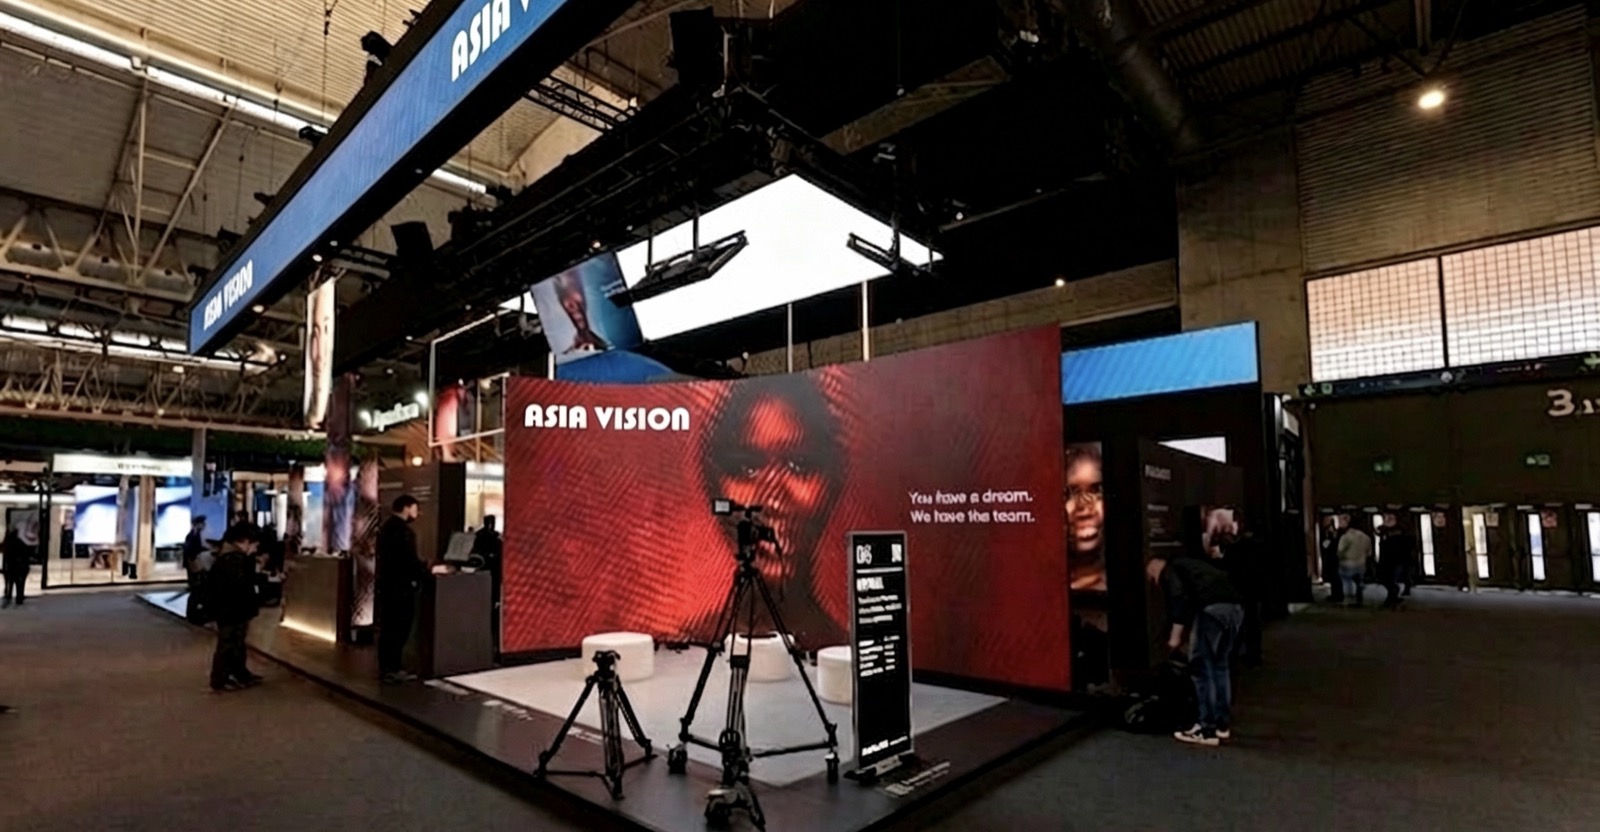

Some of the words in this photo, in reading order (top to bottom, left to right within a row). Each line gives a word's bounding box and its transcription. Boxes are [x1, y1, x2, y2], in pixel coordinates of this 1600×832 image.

[451, 0, 510, 82] ASIA
[524, 403, 588, 429] ASIA
[594, 406, 690, 431] VISION
[908, 491, 933, 504] You
[935, 489, 967, 504] have
[969, 492, 980, 503] a
[982, 488, 1033, 503] dream.
[910, 510, 932, 523] We
[934, 509, 965, 523] have
[967, 508, 990, 523] the
[992, 509, 1035, 523] team.
